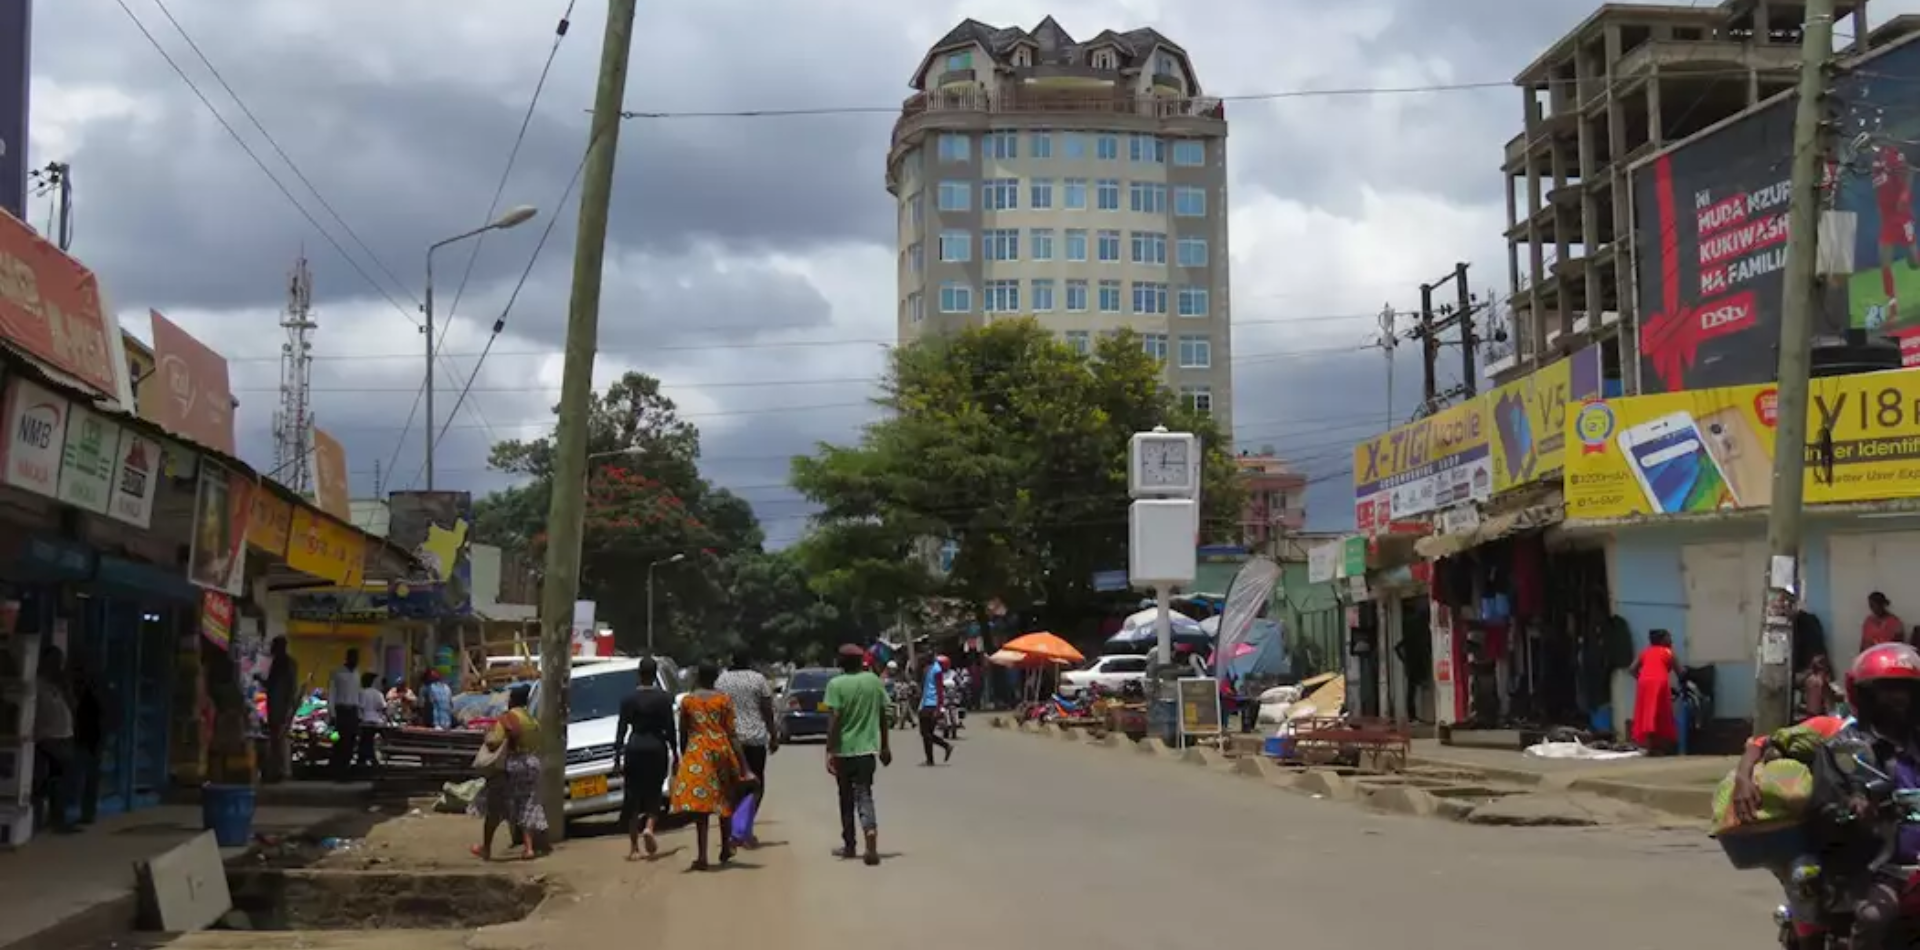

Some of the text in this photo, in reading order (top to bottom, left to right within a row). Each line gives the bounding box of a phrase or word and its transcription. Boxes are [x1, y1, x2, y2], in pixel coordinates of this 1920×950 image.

[1695, 189, 1710, 209] NI
[1697, 199, 1745, 232] MUDA
[1701, 269, 1727, 293] NA
[1538, 383, 1566, 431] V5
[17, 414, 52, 449] NMB
